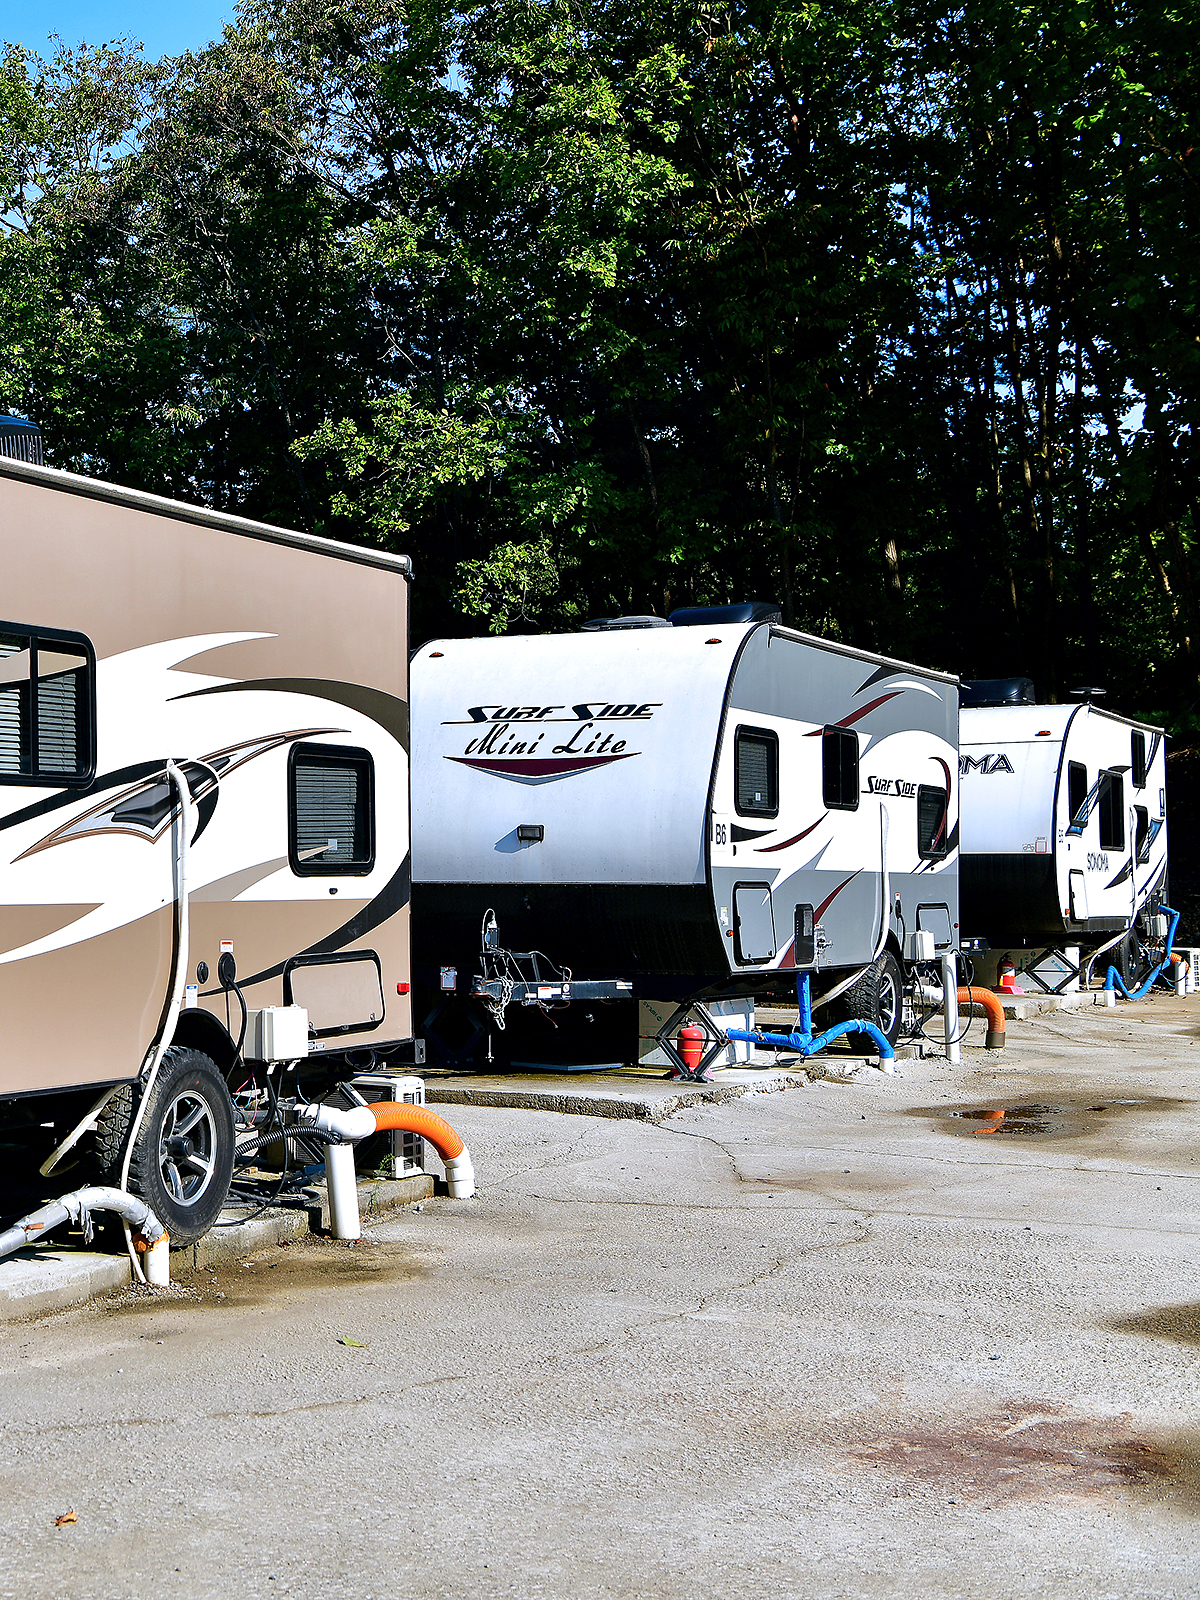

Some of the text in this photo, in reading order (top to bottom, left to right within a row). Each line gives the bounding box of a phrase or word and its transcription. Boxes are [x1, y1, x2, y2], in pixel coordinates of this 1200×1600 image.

[466, 702, 663, 723] SURF SIDE
[464, 722, 627, 755] Mini Lite
[866, 776, 917, 797] SURF SIDE
[716, 823, 726, 845] B6
